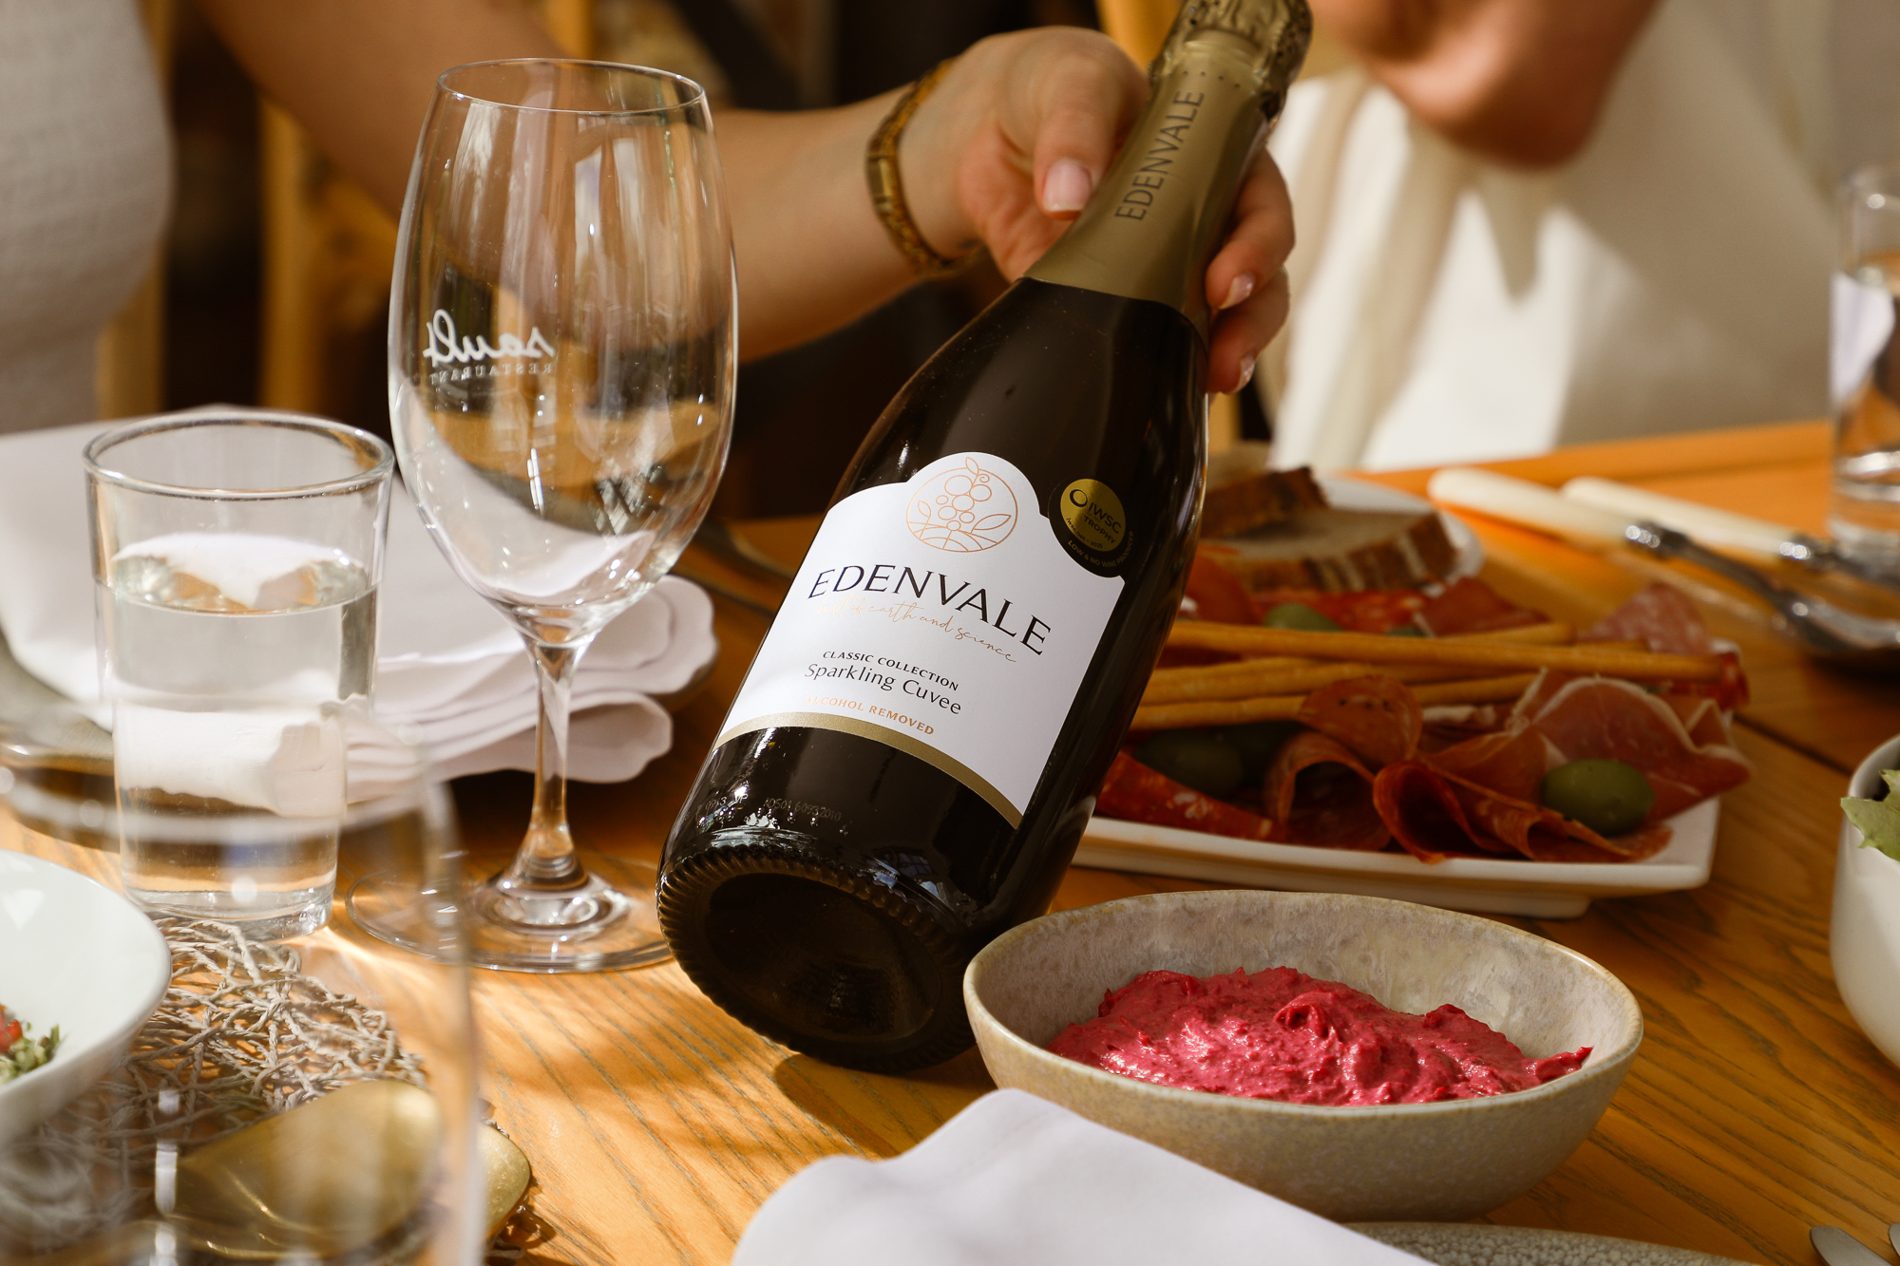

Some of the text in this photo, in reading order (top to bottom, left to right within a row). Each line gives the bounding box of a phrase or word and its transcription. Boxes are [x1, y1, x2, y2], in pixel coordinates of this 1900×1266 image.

[1115, 91, 1205, 221] EDENVALE
[1084, 515, 1116, 543] TROPHY
[1088, 502, 1122, 533] IWSC
[808, 564, 1052, 656] EDENVALE
[920, 616, 955, 633] and
[955, 627, 1016, 663] science
[805, 664, 961, 714] Sparkling Cuvee
[823, 651, 959, 691] CLASSIC COLLECTION
[869, 705, 934, 735] REMOVED
